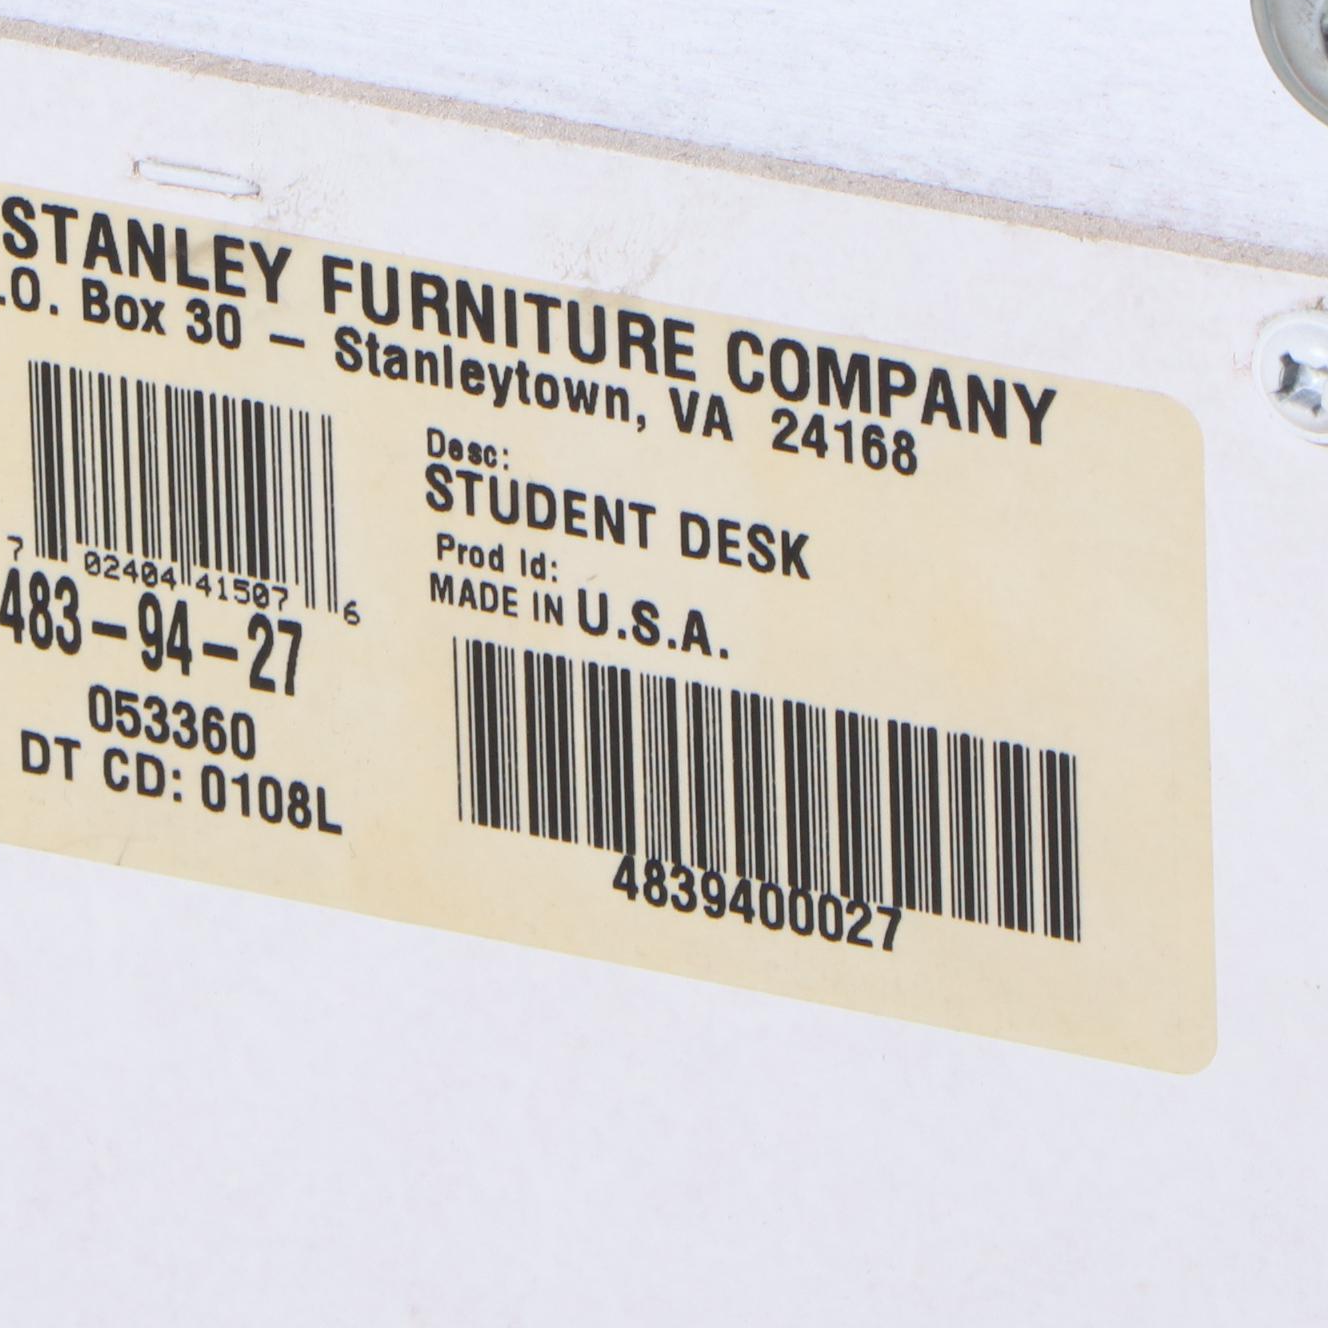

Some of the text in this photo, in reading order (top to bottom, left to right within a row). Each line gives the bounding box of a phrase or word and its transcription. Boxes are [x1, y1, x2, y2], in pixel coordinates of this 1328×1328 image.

[0, 196, 1057, 446] STANLEY FURNITURE COMPANY
[81, 277, 166, 336] Box
[185, 297, 242, 351] 30
[334, 325, 646, 433] Stanleytown,
[668, 386, 734, 442] VA
[771, 407, 918, 477] 24168
[426, 426, 509, 471] Desc:
[424, 462, 811, 581] STUDENT DESK
[436, 532, 558, 583] Prod Id:
[7, 535, 361, 626] 7 02404 41507 6
[429, 571, 729, 660] MADE IN U.S.A.
[87, 684, 257, 761] 053360
[20, 729, 343, 836] DT CD: 0108L
[612, 854, 903, 951] 4839400027
